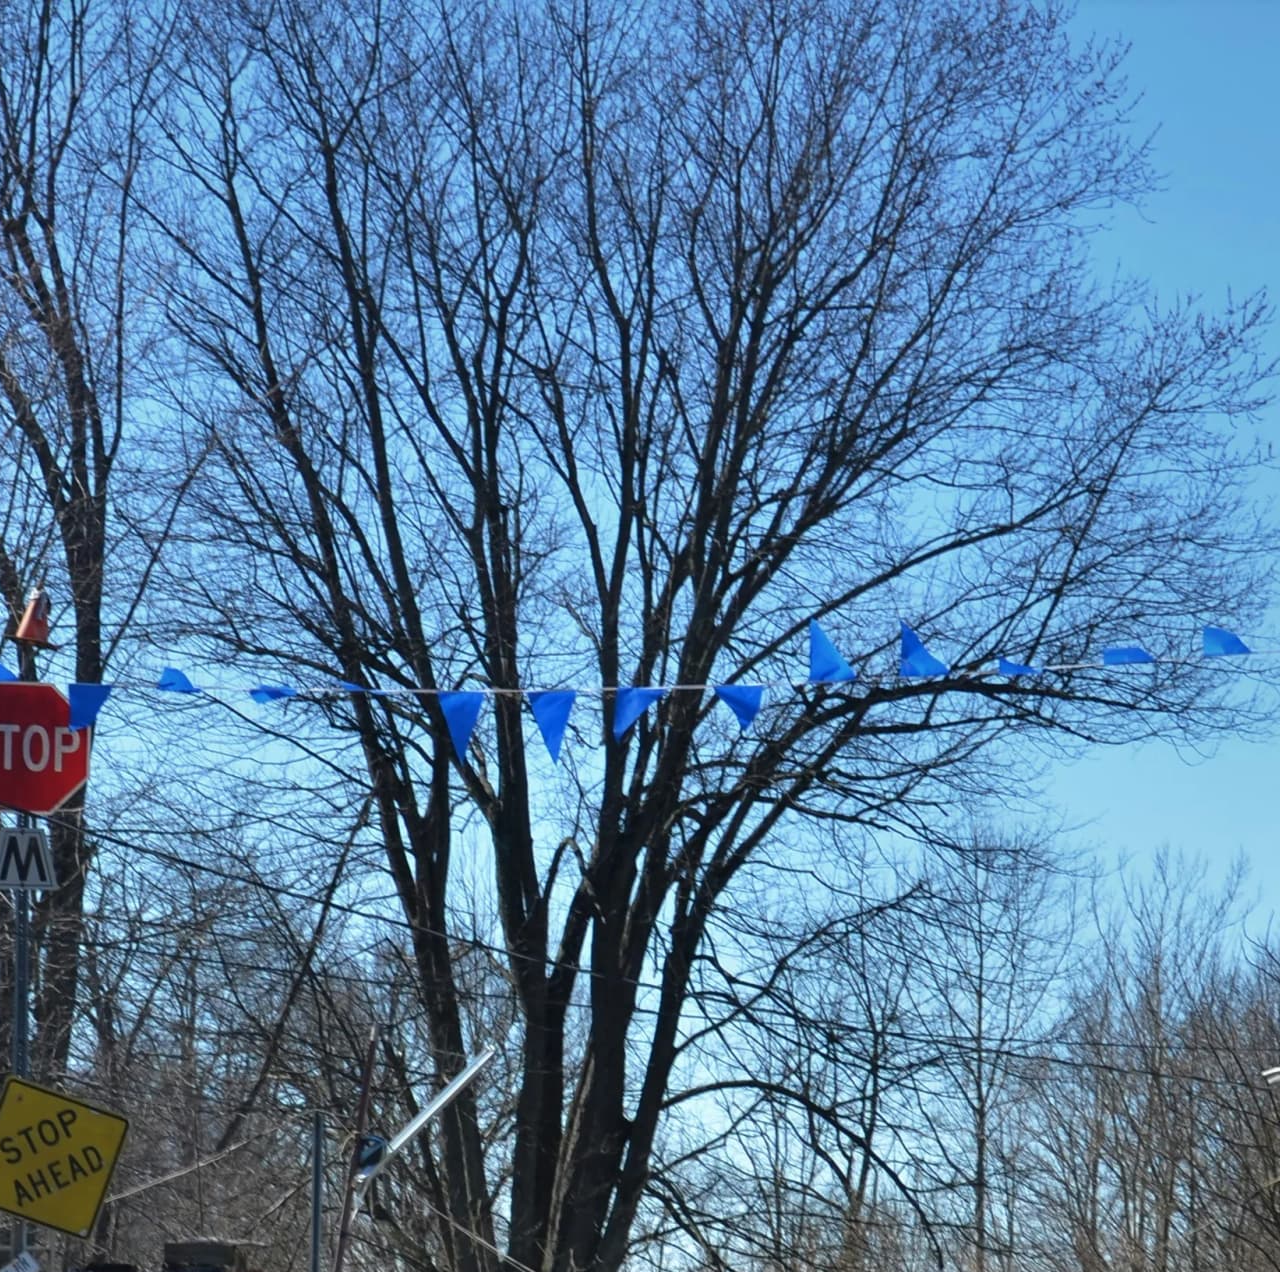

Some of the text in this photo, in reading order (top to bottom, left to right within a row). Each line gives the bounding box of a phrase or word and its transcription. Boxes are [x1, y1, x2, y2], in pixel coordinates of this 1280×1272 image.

[0, 836, 46, 881] M
[0, 1109, 79, 1165] STOP
[13, 1144, 105, 1206] AHEAD
